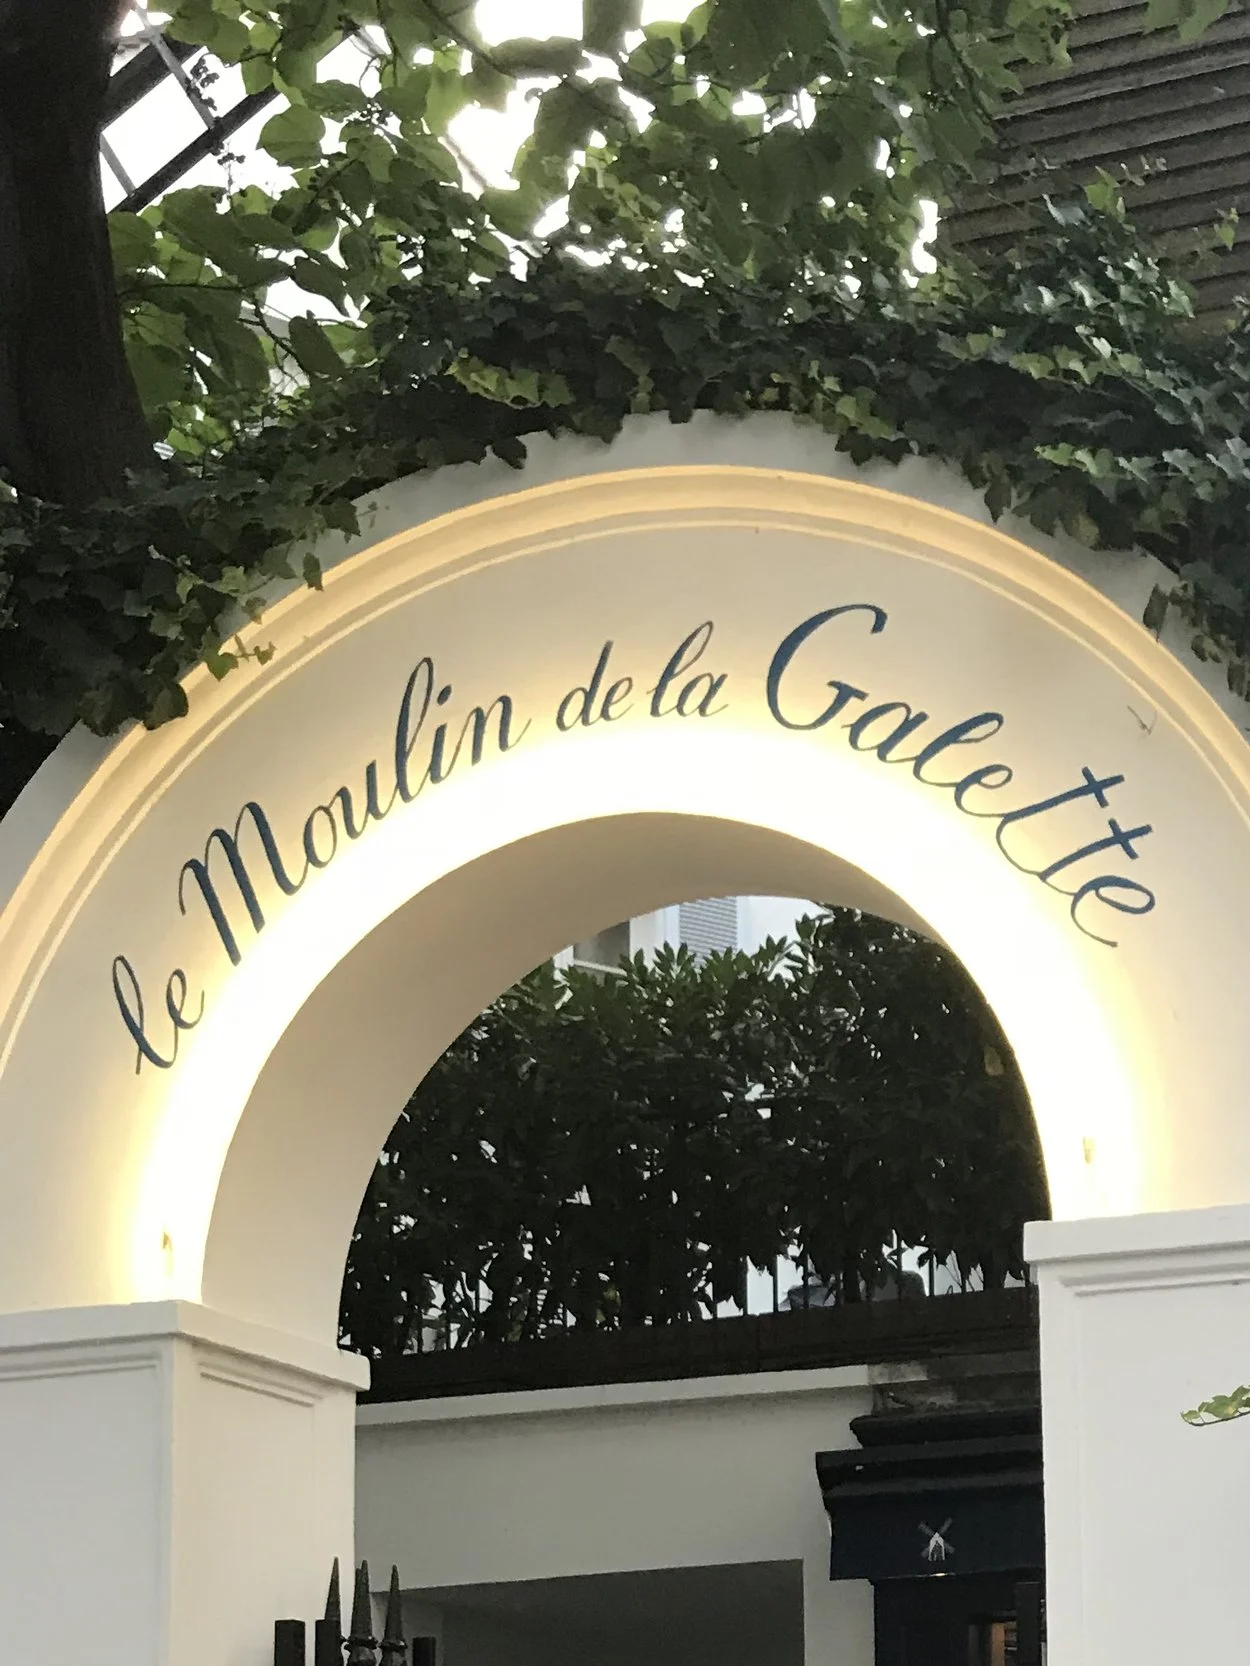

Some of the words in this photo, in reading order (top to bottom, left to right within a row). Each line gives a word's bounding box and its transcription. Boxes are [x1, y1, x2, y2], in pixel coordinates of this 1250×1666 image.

[112, 955, 205, 1075] le
[178, 656, 532, 967] Moulin
[556, 639, 634, 732] de
[646, 619, 729, 718] la
[766, 603, 1155, 948] Galette
